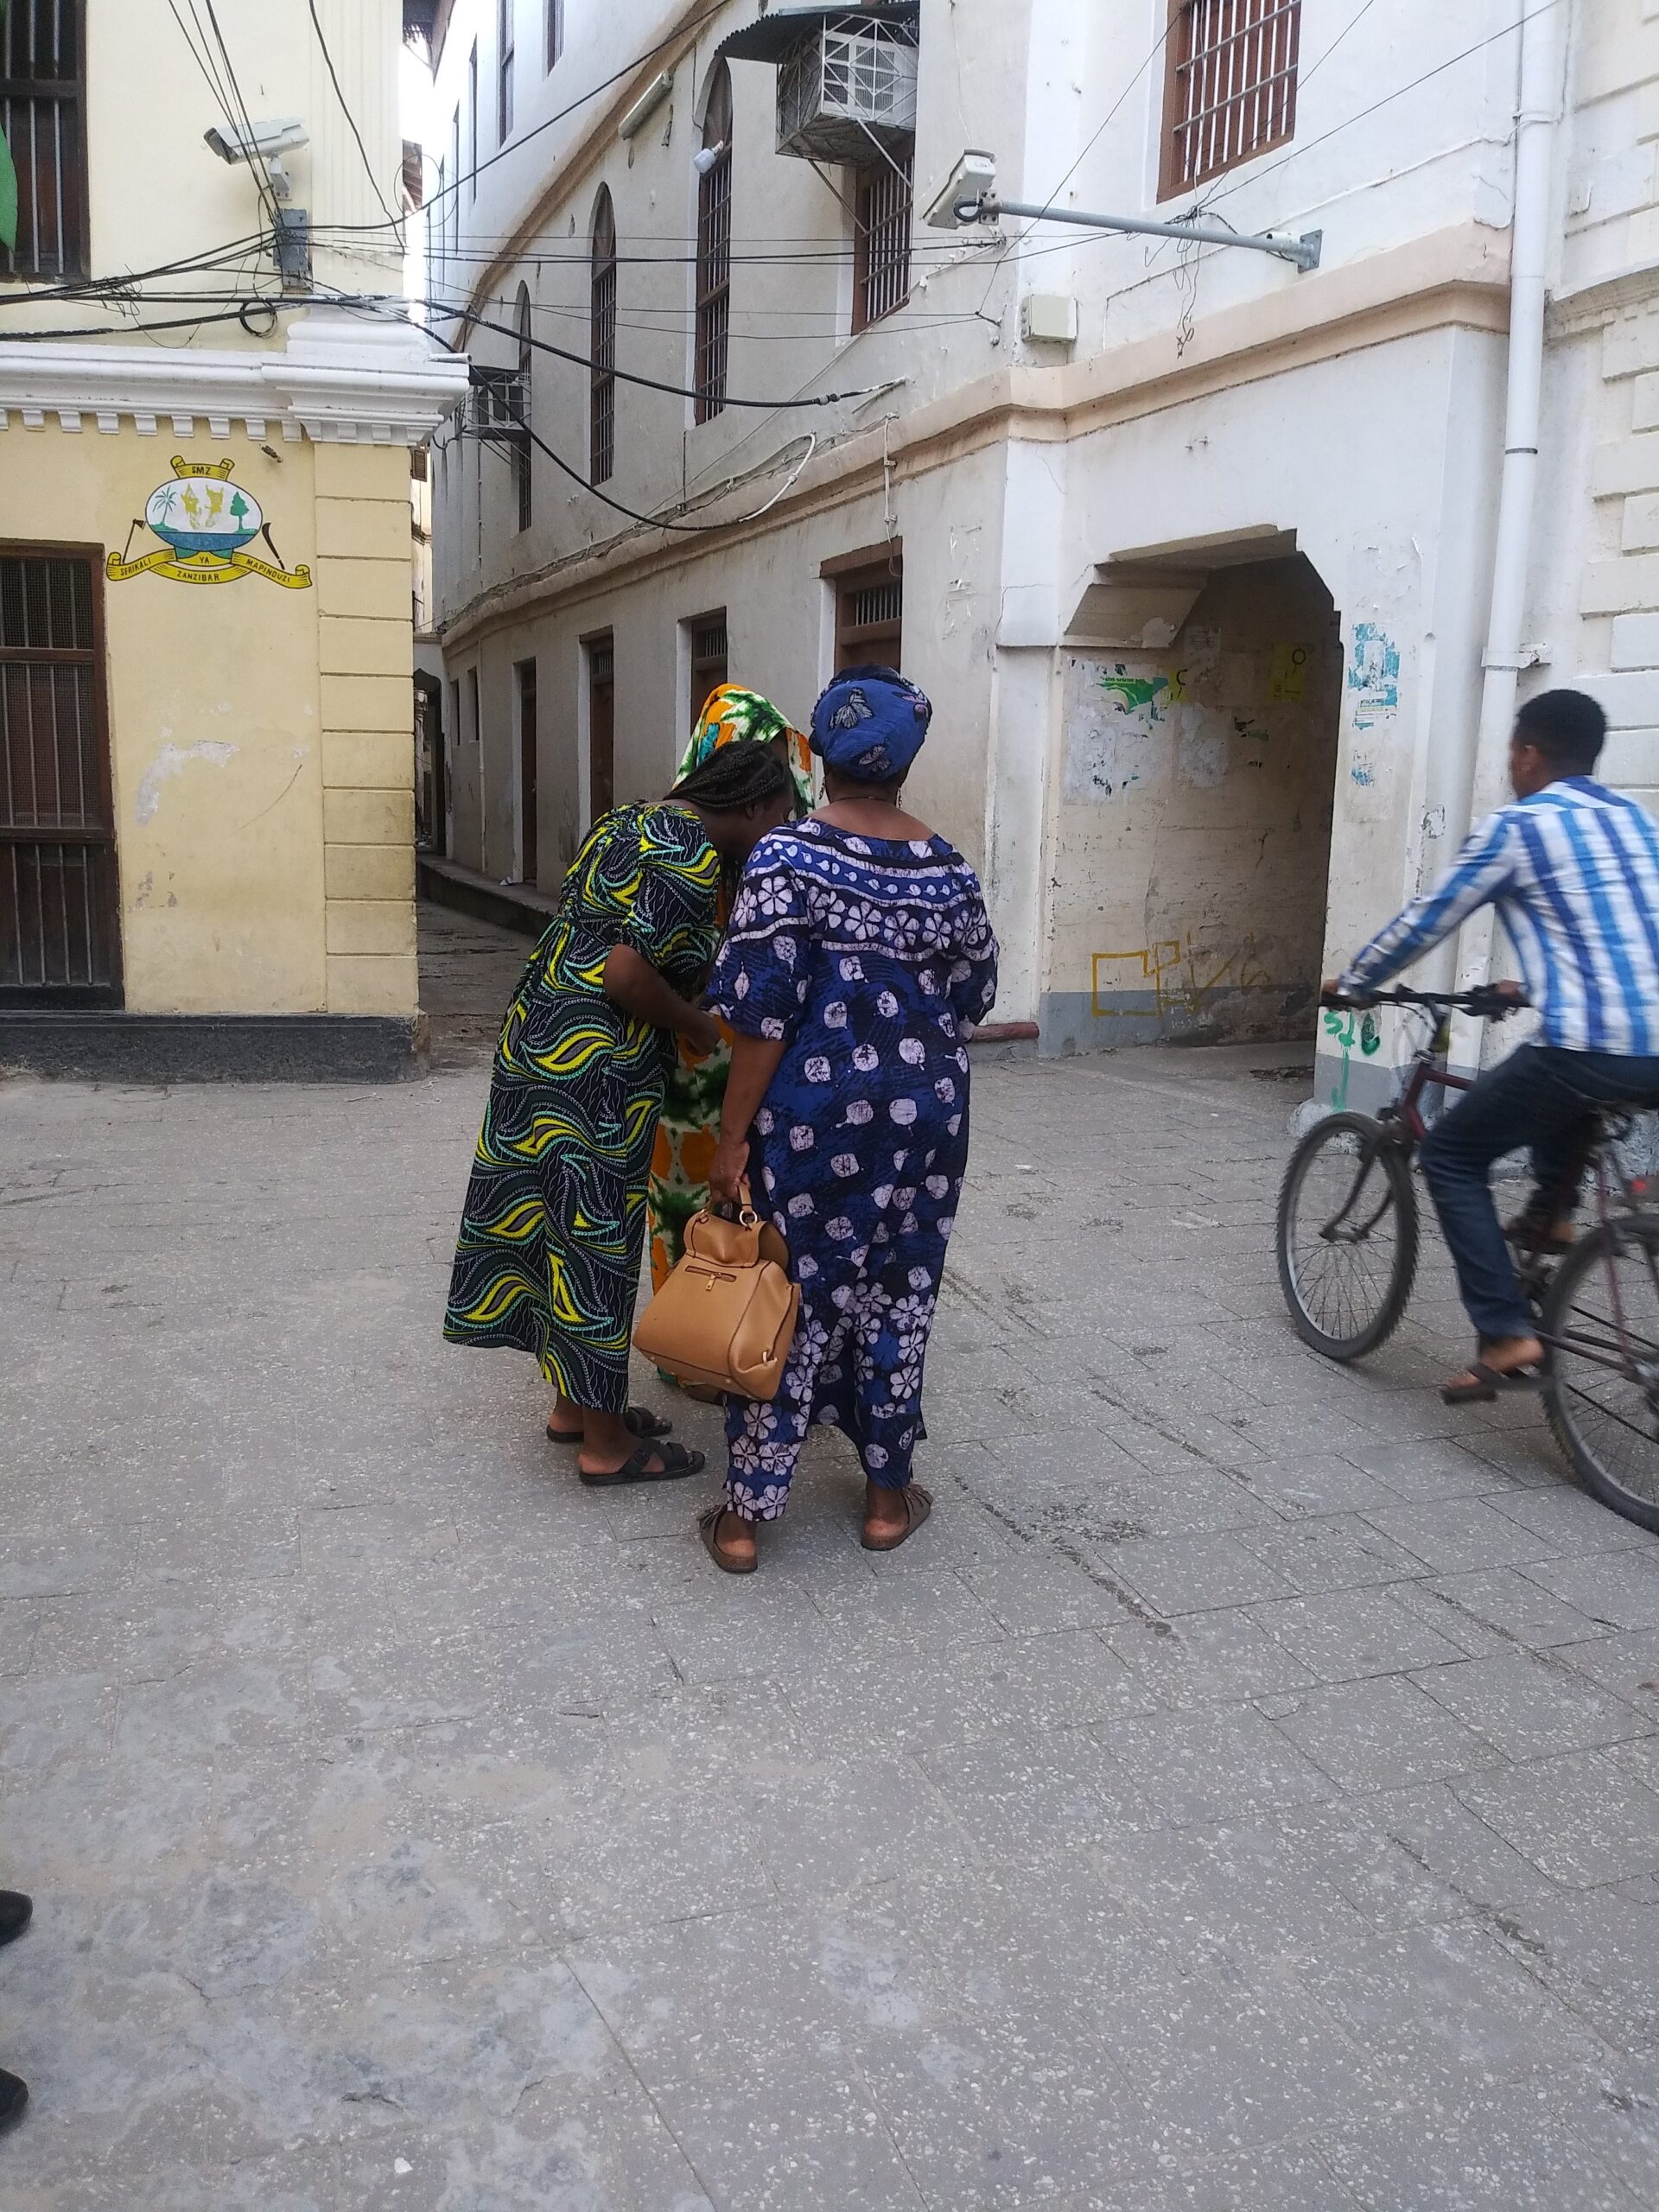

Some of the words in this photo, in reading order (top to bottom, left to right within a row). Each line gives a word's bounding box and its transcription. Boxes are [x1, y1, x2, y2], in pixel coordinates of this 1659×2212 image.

[191, 466, 211, 475] SMZ
[120, 558, 151, 576] SERIKALI
[246, 558, 291, 583] MAPINDUZI
[176, 571, 219, 581] ZANZIBAR
